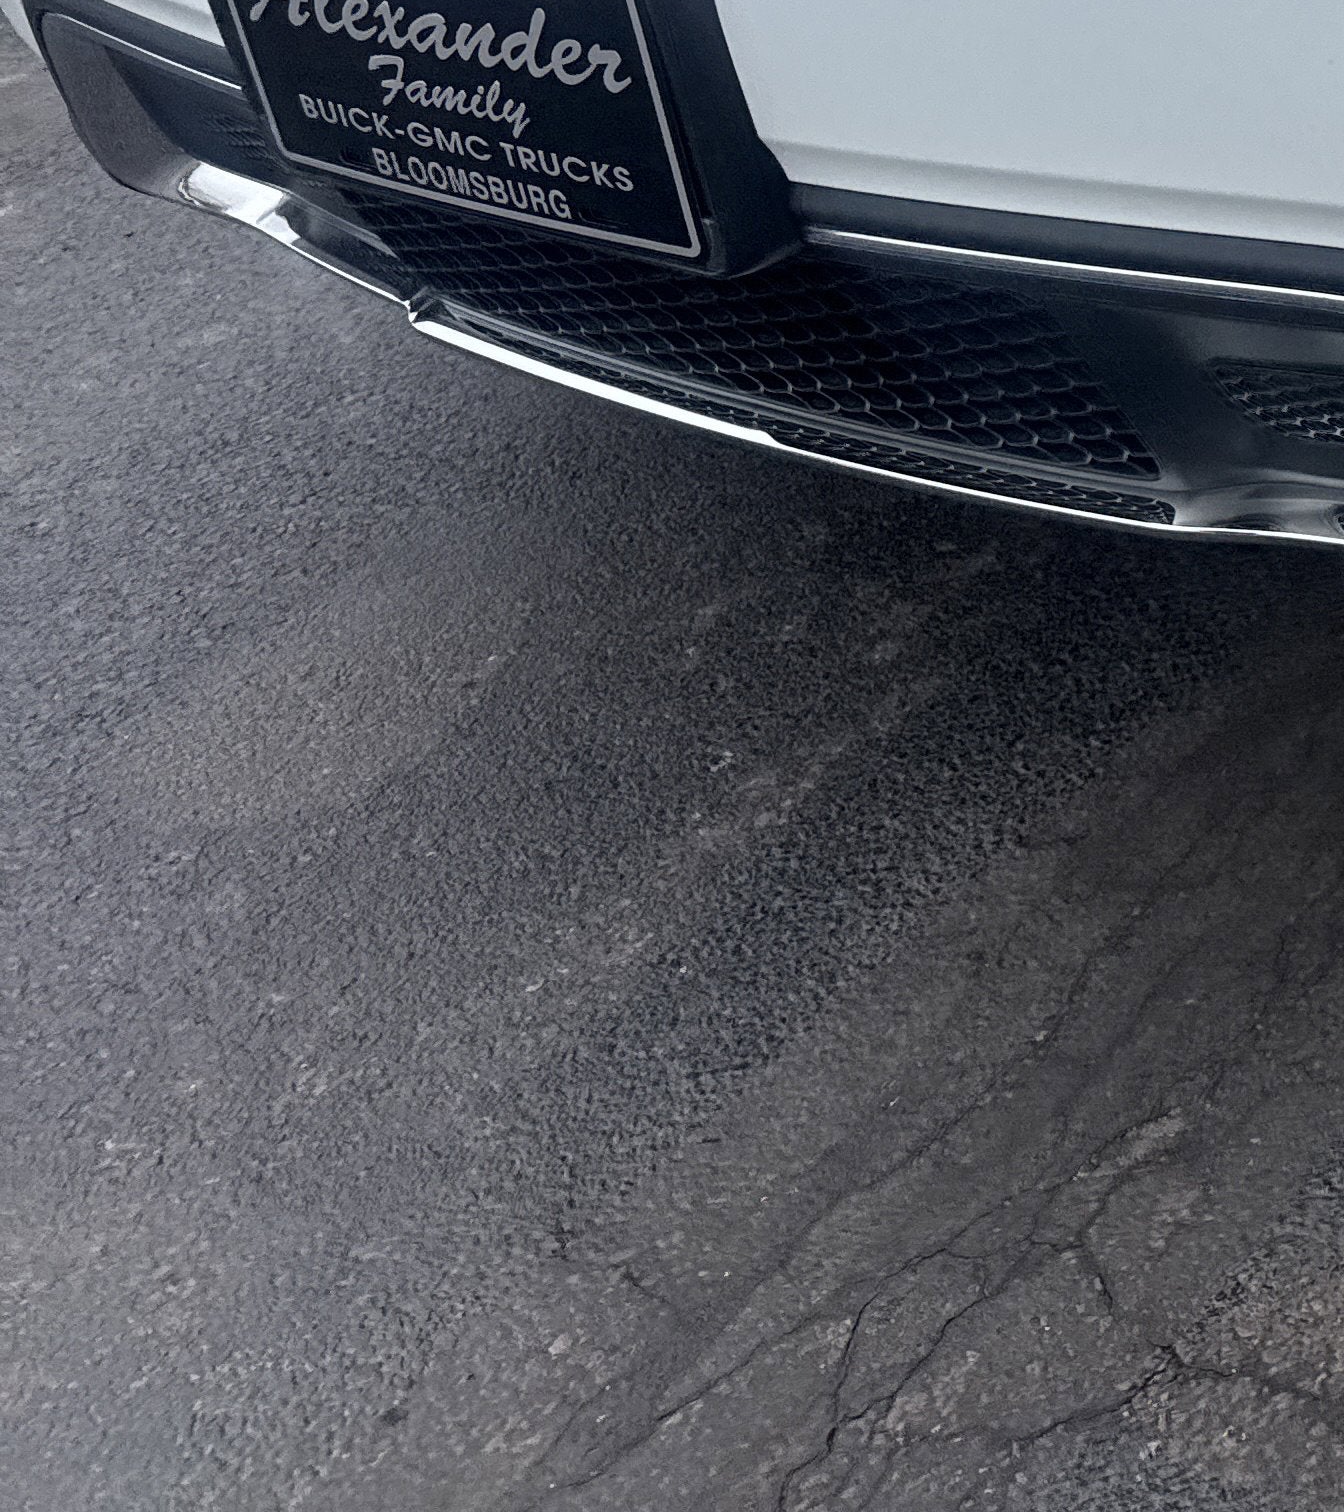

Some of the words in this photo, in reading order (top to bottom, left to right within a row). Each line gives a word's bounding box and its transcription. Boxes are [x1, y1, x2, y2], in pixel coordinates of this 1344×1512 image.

[367, 54, 531, 139] Family
[298, 93, 493, 161] BUICK-GMC
[498, 141, 635, 192] TRUCKS
[371, 147, 573, 220] BLOOMSBURG
